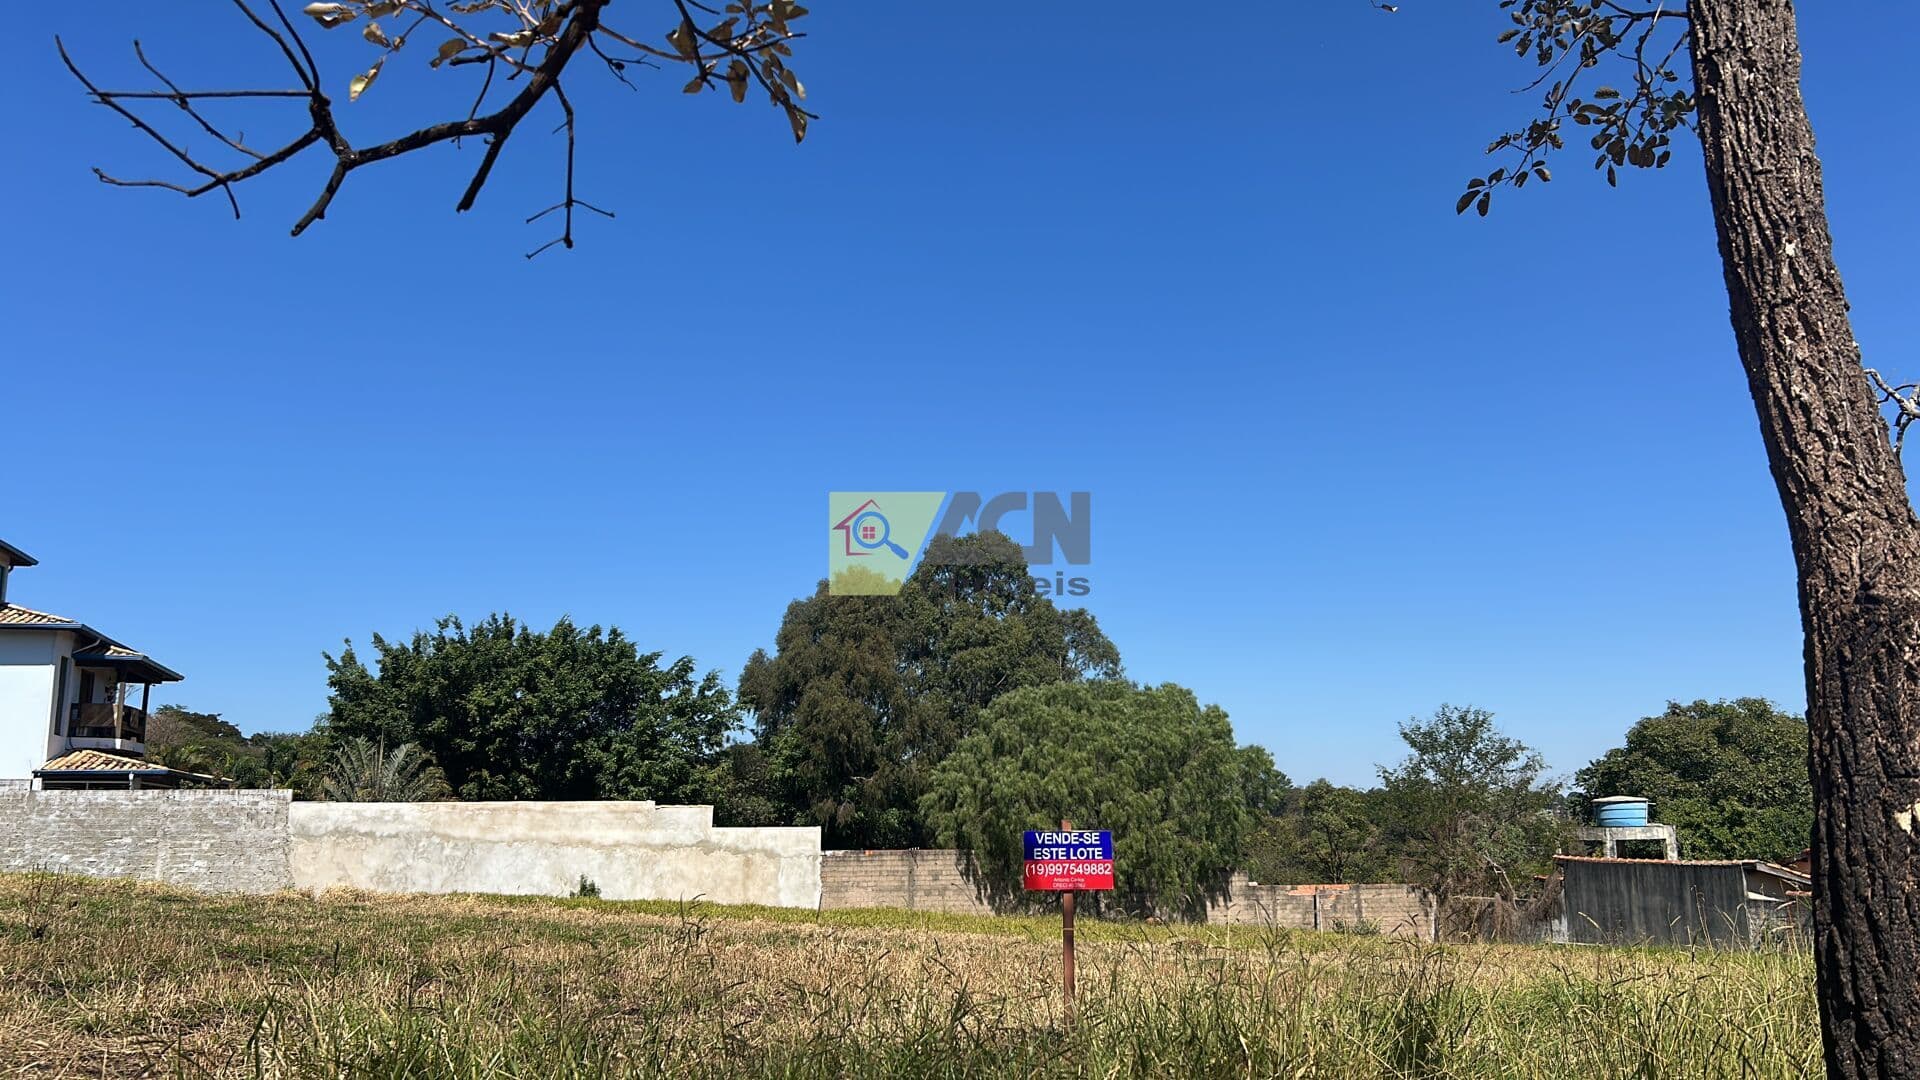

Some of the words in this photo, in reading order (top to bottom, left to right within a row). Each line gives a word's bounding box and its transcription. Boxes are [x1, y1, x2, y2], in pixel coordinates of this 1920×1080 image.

[1035, 832, 1100, 844] VENDE-SE
[1034, 848, 1066, 859] ESTE
[1070, 848, 1103, 859] LOTE
[1025, 863, 1112, 877] (19)997549882
